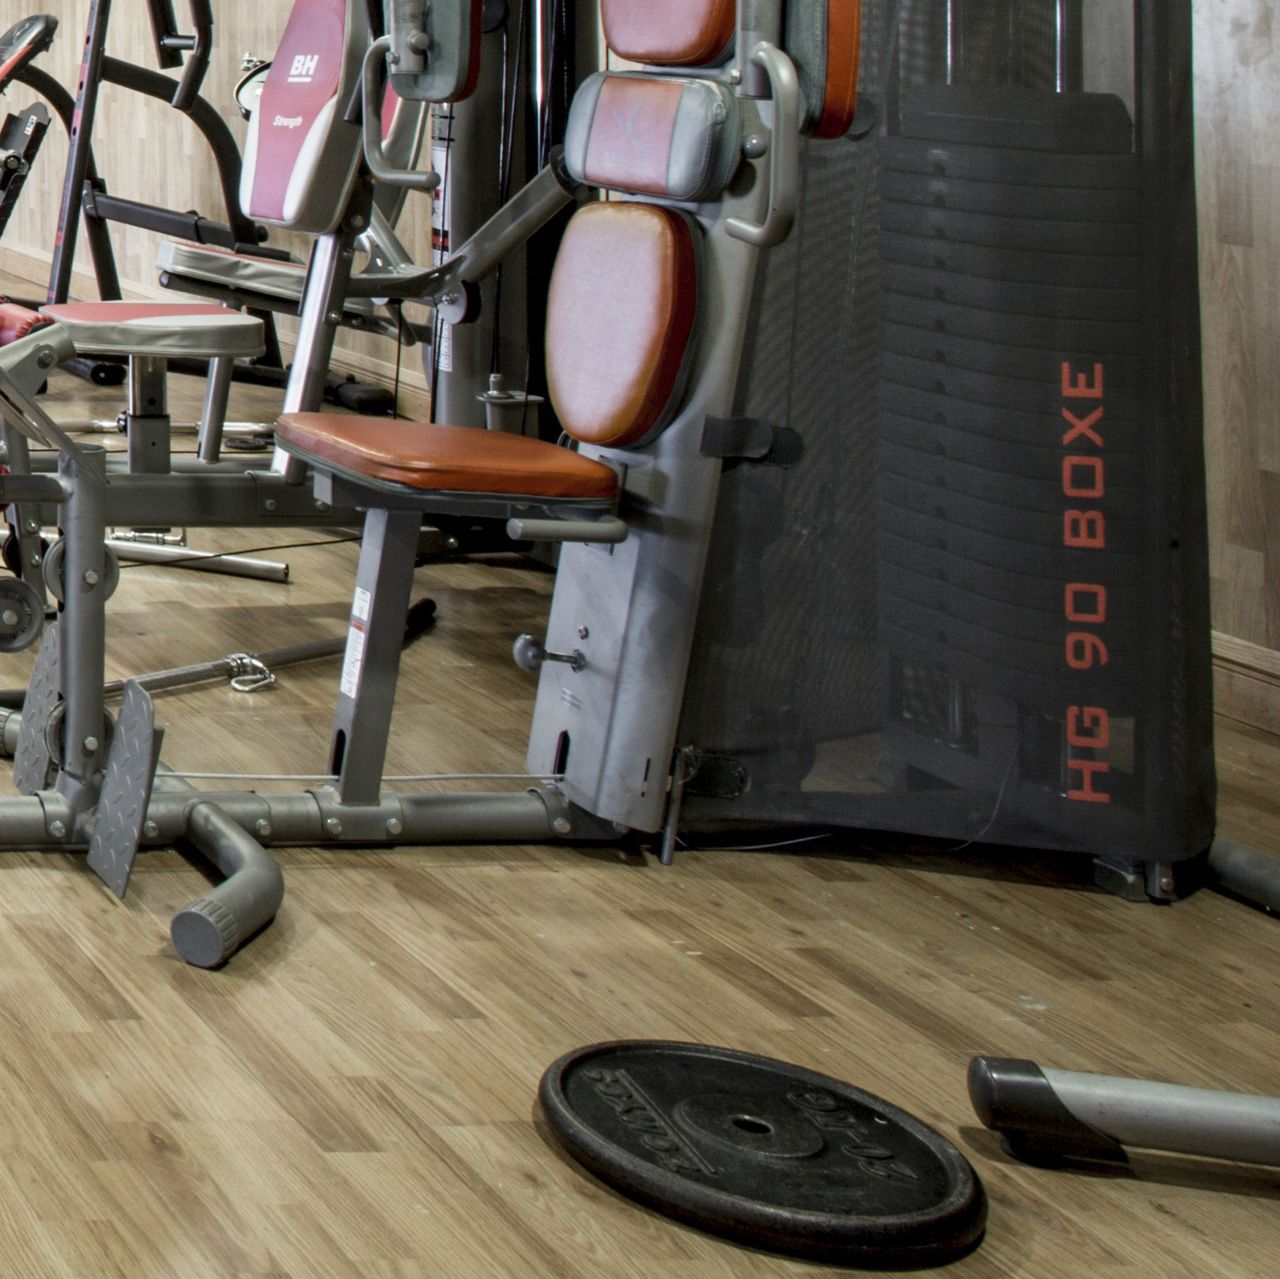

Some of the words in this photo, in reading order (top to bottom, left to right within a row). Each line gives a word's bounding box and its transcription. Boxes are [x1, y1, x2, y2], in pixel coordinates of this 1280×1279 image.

[289, 54, 319, 76] BH
[1061, 361, 1105, 549] BOXE
[1064, 582, 1109, 670] 90
[1066, 705, 1111, 804] HG
